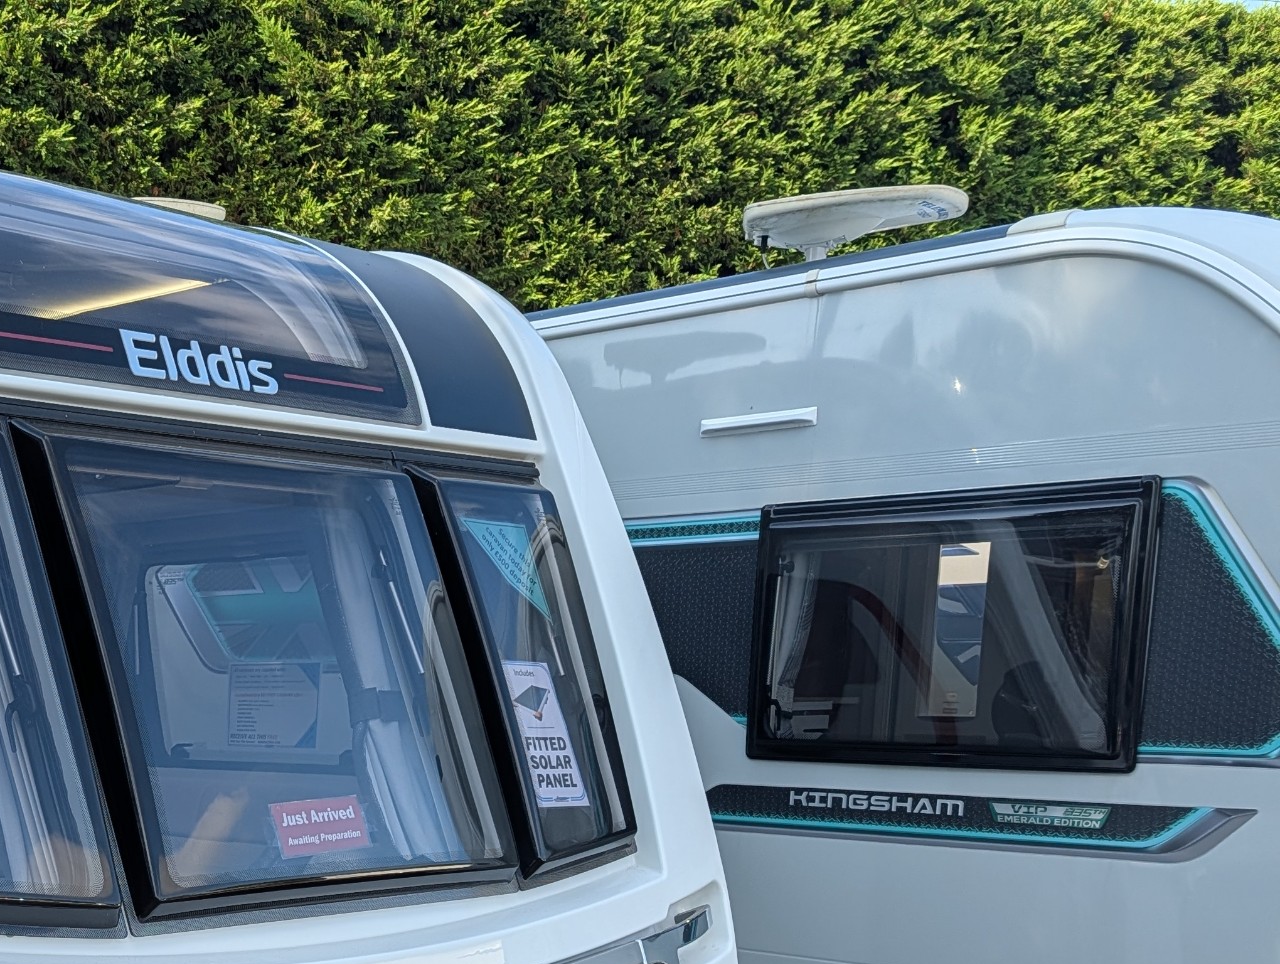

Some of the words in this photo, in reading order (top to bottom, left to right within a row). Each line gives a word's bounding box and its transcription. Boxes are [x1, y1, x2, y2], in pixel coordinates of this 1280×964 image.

[118, 328, 279, 395] Elddis
[485, 526, 508, 556] caravan
[508, 554, 526, 577] today
[526, 573, 537, 586] for
[497, 527, 519, 554] Secure
[518, 552, 531, 568] this
[481, 533, 495, 552] only
[509, 569, 534, 596] deposit
[524, 736, 567, 751] FITTED
[529, 754, 573, 770] SOLAR
[536, 773, 578, 788] PANEL
[788, 790, 966, 817] KINGSHAM
[1010, 804, 1048, 815] VIP
[282, 810, 309, 827] Just
[310, 805, 356, 823] Arrived
[997, 814, 1051, 825] EMERALD
[1053, 818, 1101, 829] EDITION
[288, 833, 320, 846] Awaiting
[320, 829, 362, 842] Preparation
